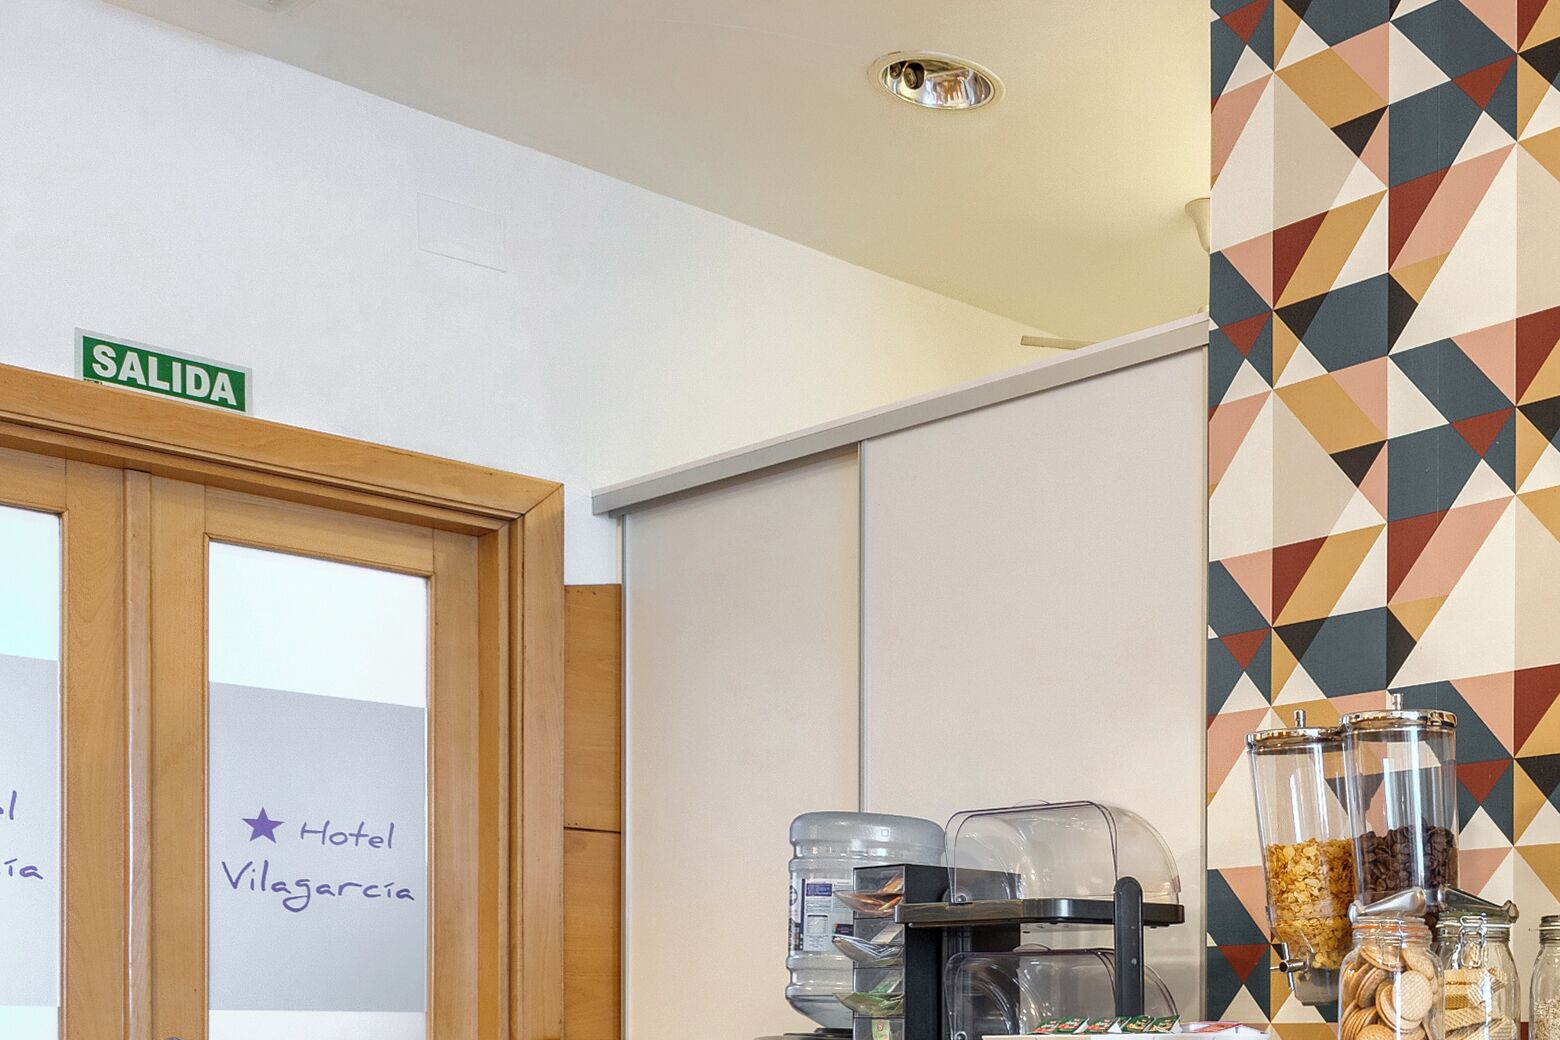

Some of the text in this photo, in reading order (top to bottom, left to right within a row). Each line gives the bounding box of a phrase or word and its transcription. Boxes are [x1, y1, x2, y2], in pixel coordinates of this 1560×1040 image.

[92, 344, 238, 406] SALIDA
[300, 820, 395, 849] Hotel
[221, 859, 416, 913] Vilagarcía
